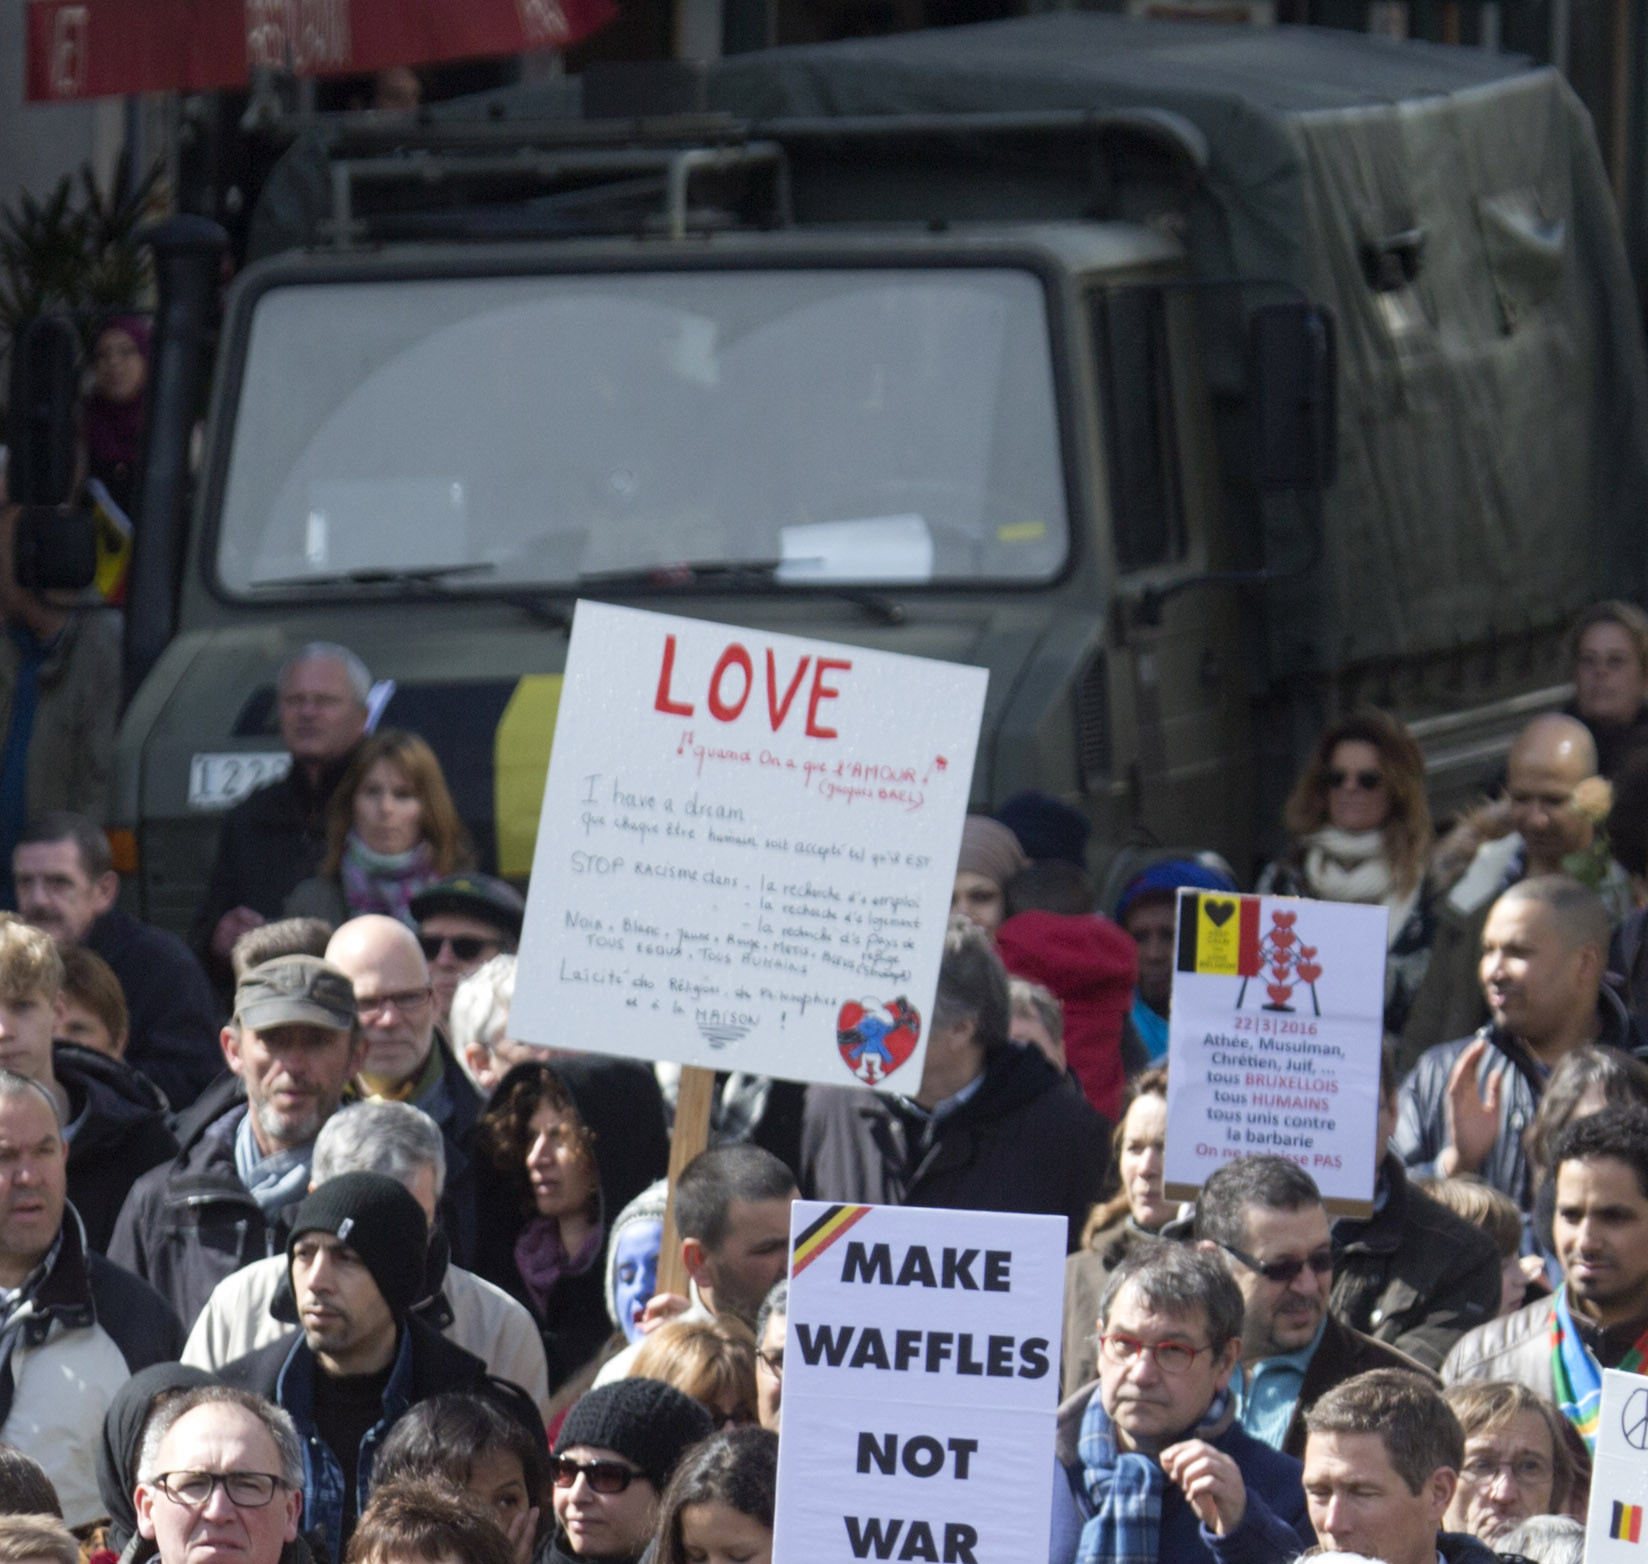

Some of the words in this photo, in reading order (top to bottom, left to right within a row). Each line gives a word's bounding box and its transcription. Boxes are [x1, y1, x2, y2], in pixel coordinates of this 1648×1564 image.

[654, 634, 852, 739] LOVE
[581, 772, 603, 804] I
[613, 776, 655, 809] have
[664, 798, 673, 813] a
[685, 792, 744, 822] dream
[571, 850, 624, 875] STOP
[1259, 1038, 1346, 1060] Musulman,
[1207, 1070, 1240, 1086] tous
[1245, 1074, 1340, 1094] BRUXELLOIS
[1214, 1090, 1247, 1106] tous
[1252, 1094, 1330, 1113] HUMAINS
[1207, 1107, 1242, 1123] tous
[1247, 1108, 1280, 1126] unis
[1284, 1113, 1336, 1131] contre
[1226, 1125, 1244, 1143] la
[1246, 1127, 1314, 1148] barbarie
[1195, 1143, 1218, 1158] On
[1313, 1153, 1343, 1169] PAS
[840, 1241, 1012, 1292] MAKE
[795, 1323, 1050, 1380] WAFFLES
[856, 1432, 978, 1480] NOT
[843, 1516, 979, 1564] WAR
